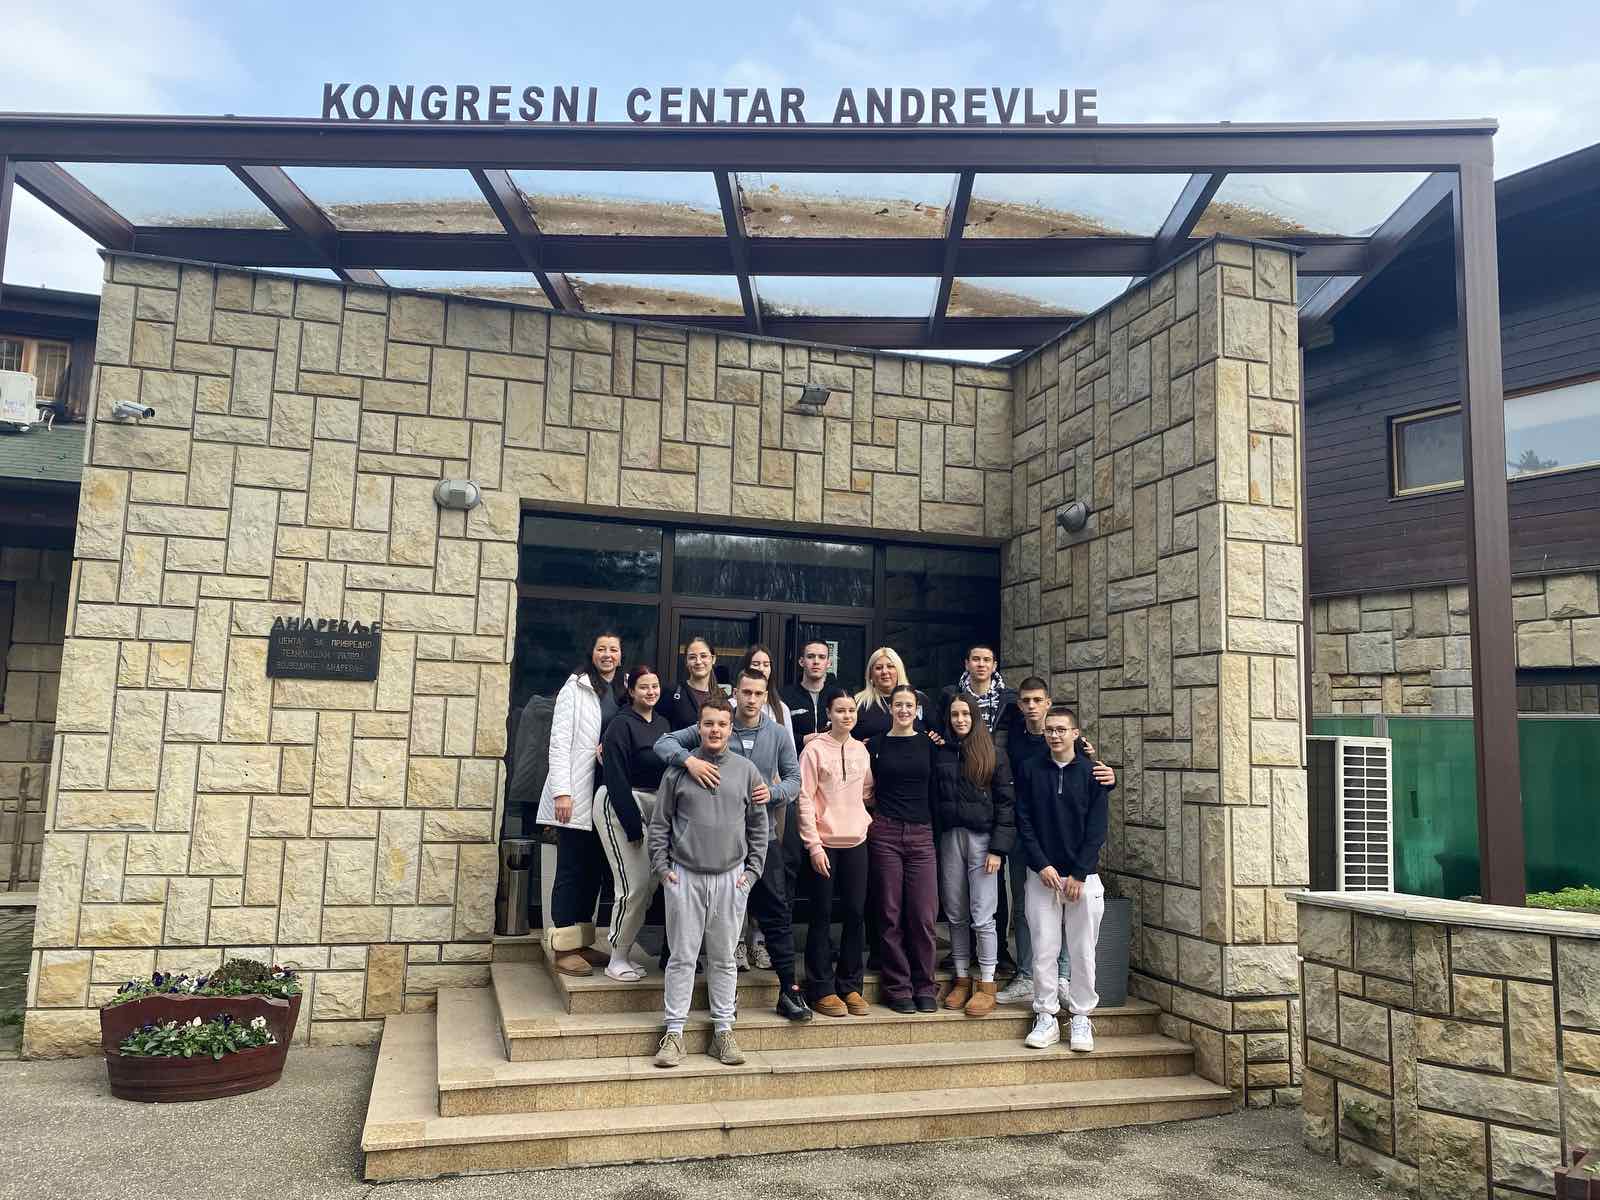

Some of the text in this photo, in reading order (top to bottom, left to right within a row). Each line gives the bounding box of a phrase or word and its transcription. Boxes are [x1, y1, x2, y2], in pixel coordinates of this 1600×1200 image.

[320, 82, 1099, 125] KONGRESNI CENTAR ANDREVLJE
